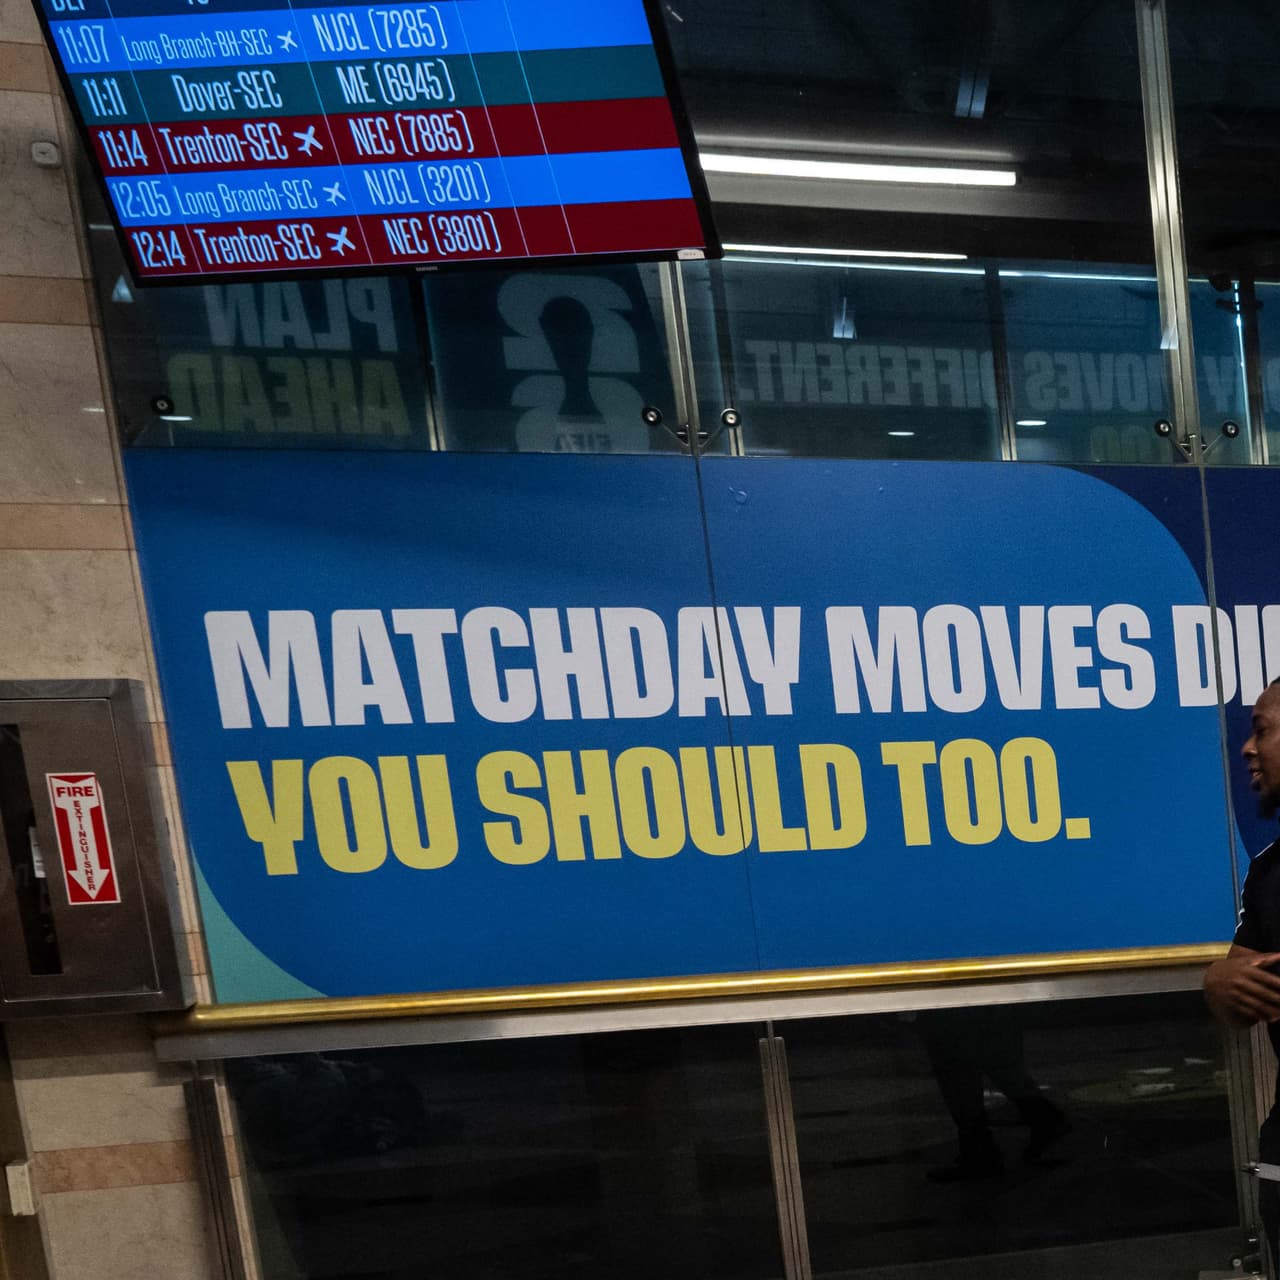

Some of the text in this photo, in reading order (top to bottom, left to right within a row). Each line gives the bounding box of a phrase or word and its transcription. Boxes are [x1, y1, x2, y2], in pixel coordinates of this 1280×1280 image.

[58, 24, 110, 64] 11:07
[121, 35, 161, 64] Long
[312, 12, 370, 52] NJCL
[368, 4, 448, 52] (7285)
[82, 57, 456, 117] 11:11 Dover-SEC ME (6945)
[98, 109, 475, 168] 11:14 Trenton-SEC NEC (7885)
[112, 160, 491, 219] 12:05 Long Branch-SEC NJCL (3201)
[131, 211, 502, 268] 12:14 Trenton-SEC NEC (3801)
[204, 606, 801, 729] MATCHDAY
[825, 603, 1156, 714] MOVES
[56, 786, 95, 798] FIRE
[225, 736, 1091, 876] YOU SHOULD TOO.
[73, 800, 96, 891] EXTINGUISHER
